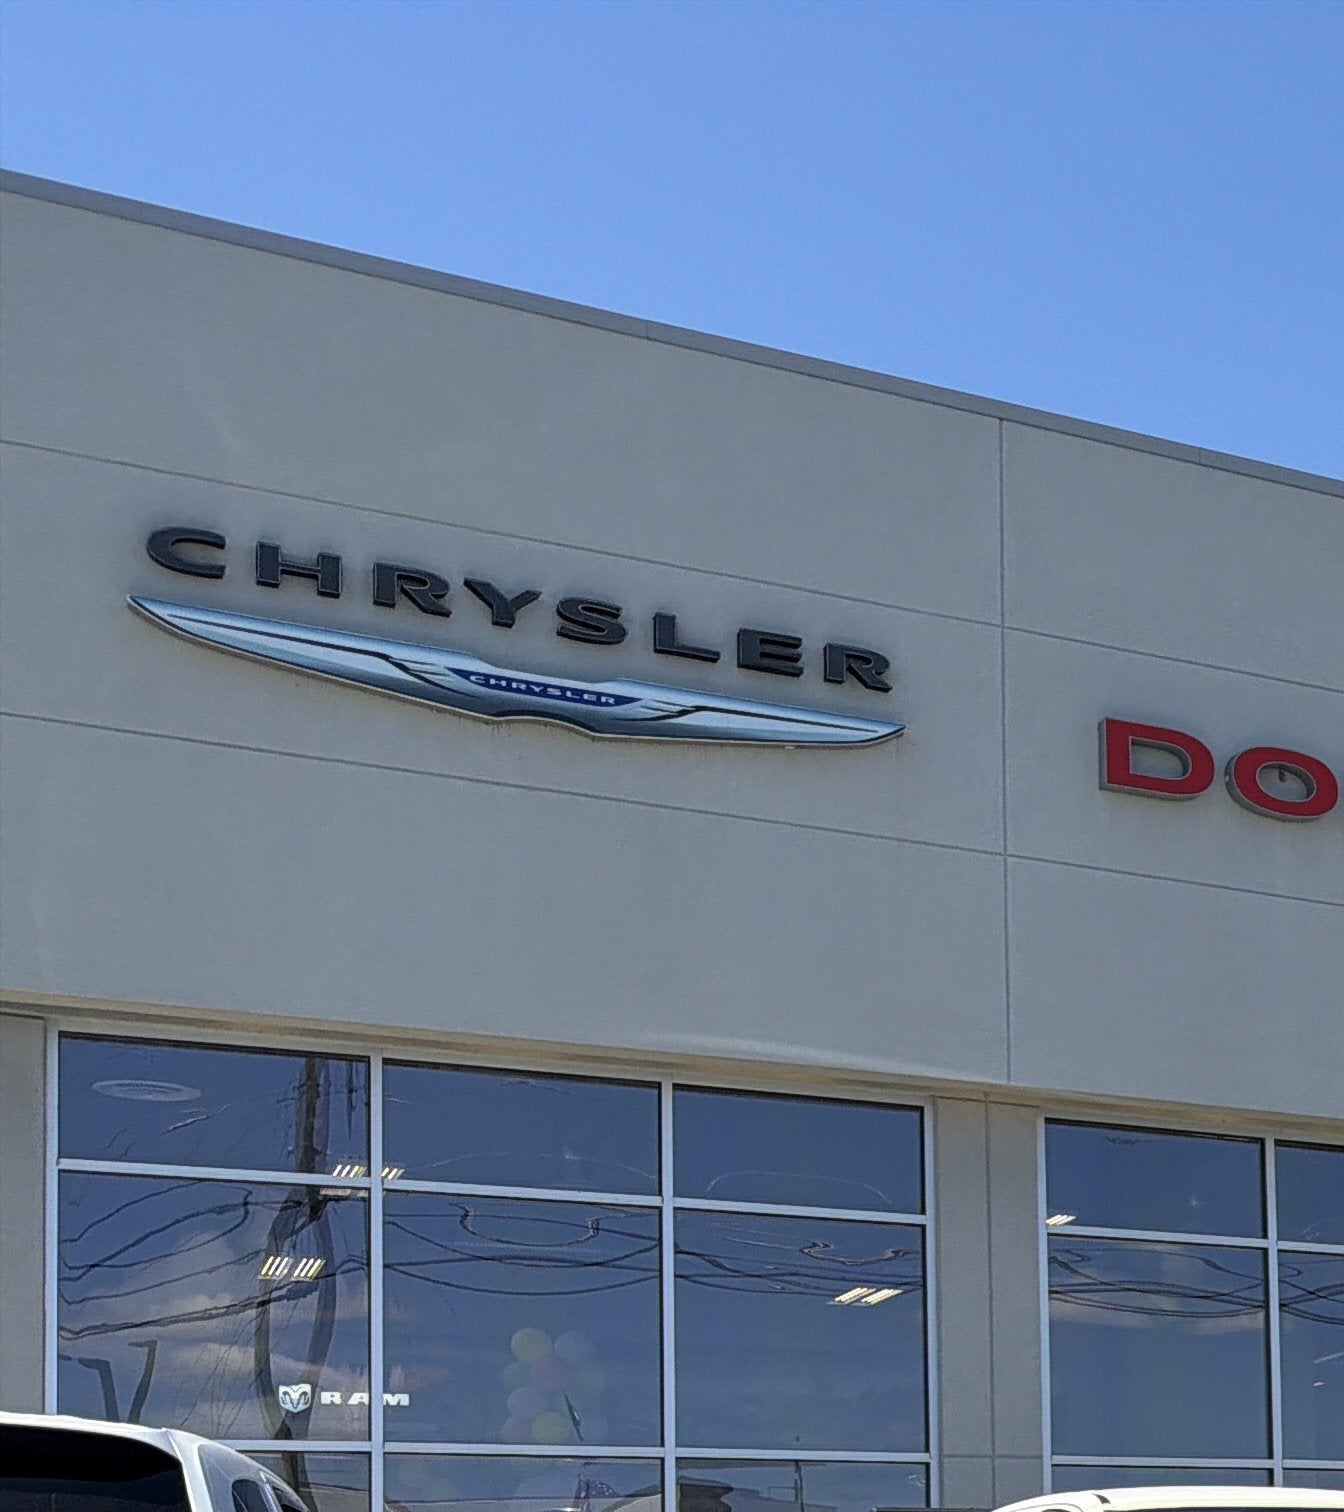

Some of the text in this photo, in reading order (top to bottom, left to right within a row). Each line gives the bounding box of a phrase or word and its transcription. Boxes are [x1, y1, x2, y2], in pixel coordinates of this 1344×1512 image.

[146, 526, 894, 693] CHRYSLER
[469, 675, 616, 705] CHRYSLER
[320, 1391, 410, 1406] RAM
